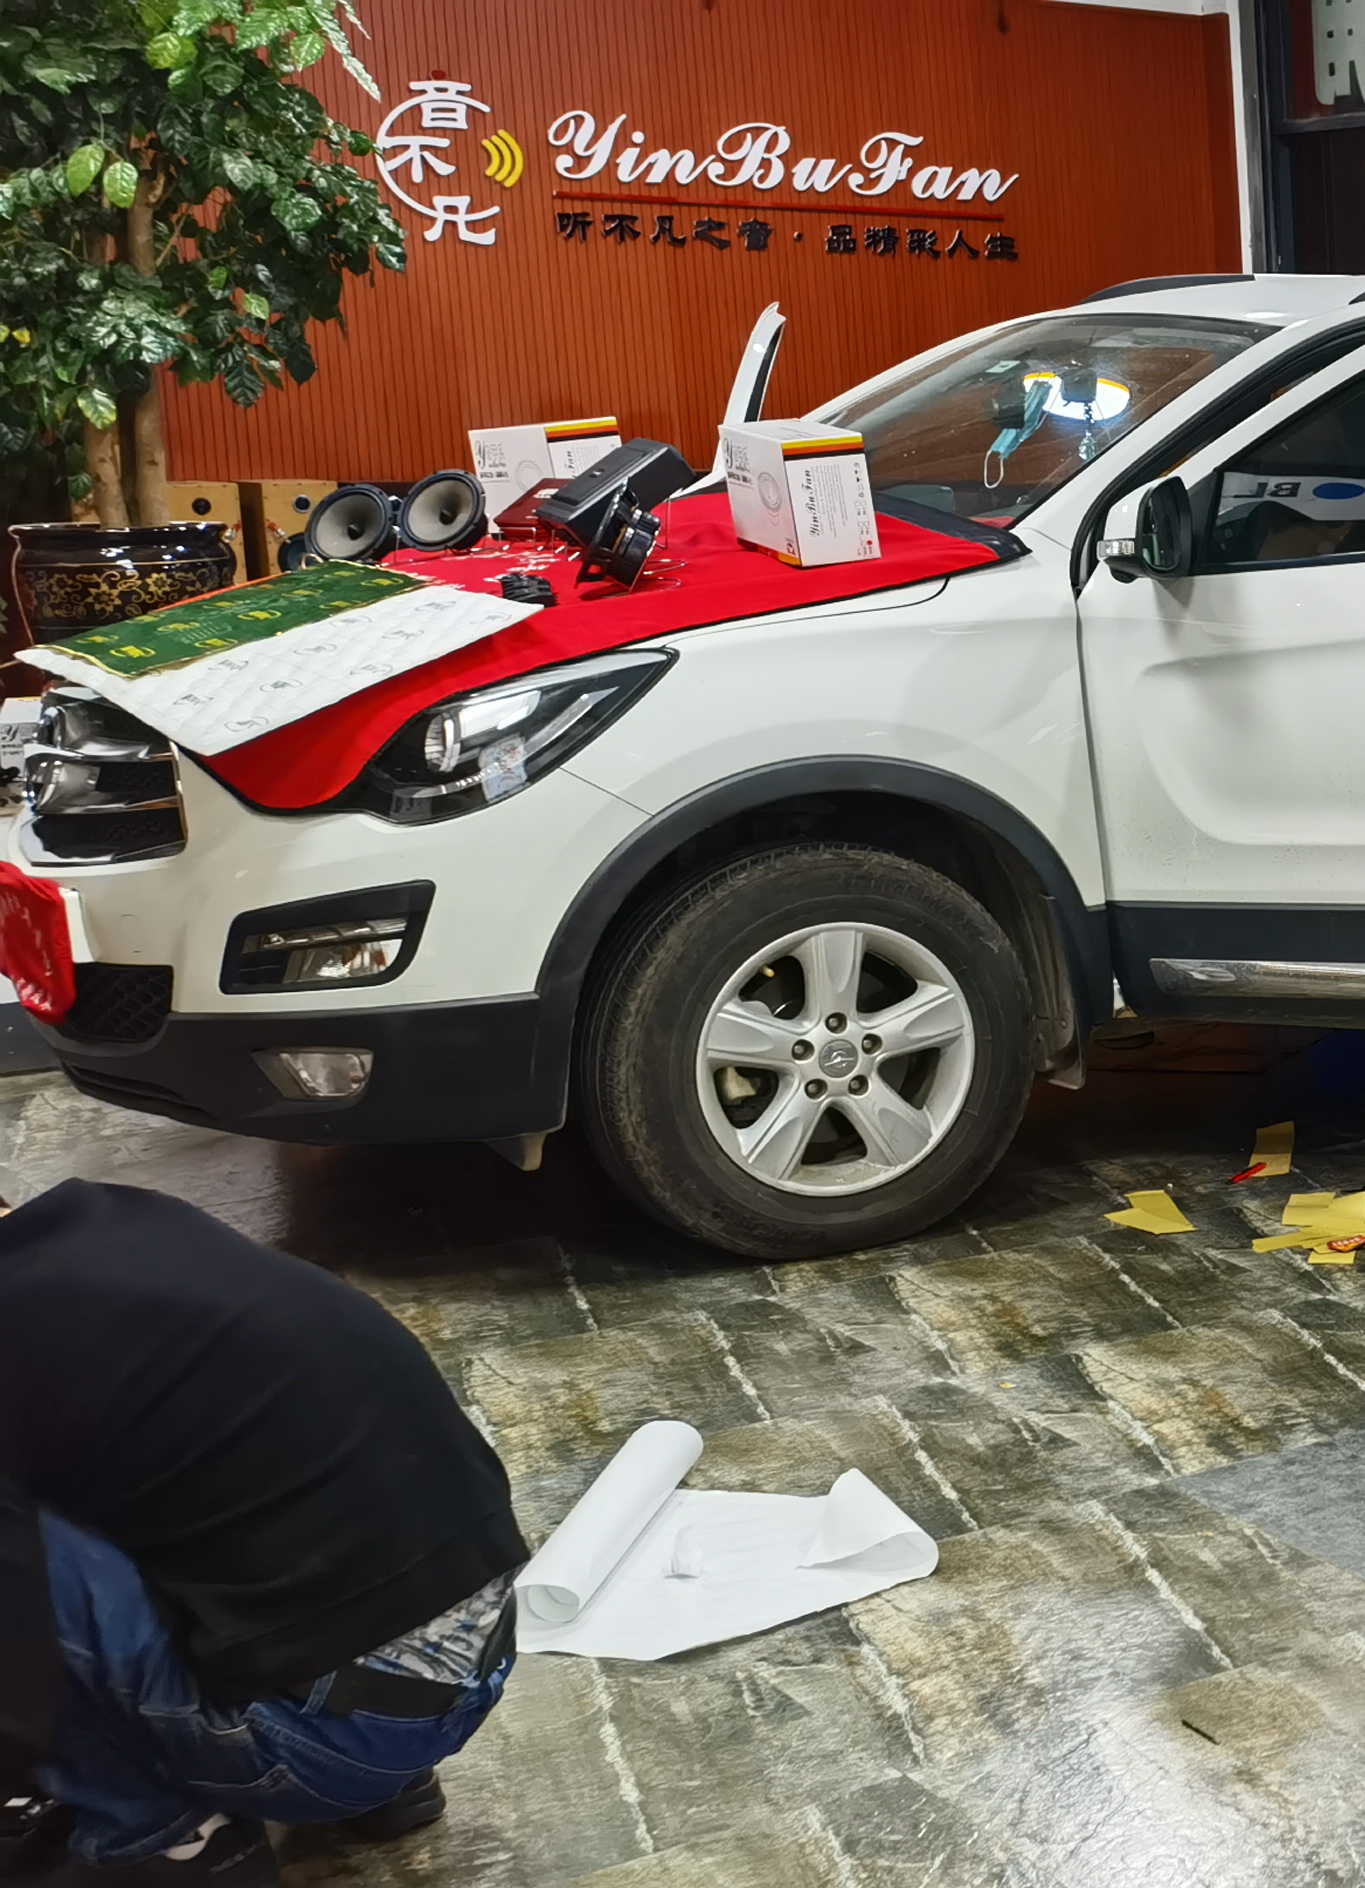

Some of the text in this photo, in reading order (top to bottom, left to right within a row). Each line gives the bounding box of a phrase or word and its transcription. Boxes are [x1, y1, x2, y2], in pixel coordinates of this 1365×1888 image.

[376, 79, 501, 247] 音不凡
[546, 109, 1019, 203] YinBuFan
